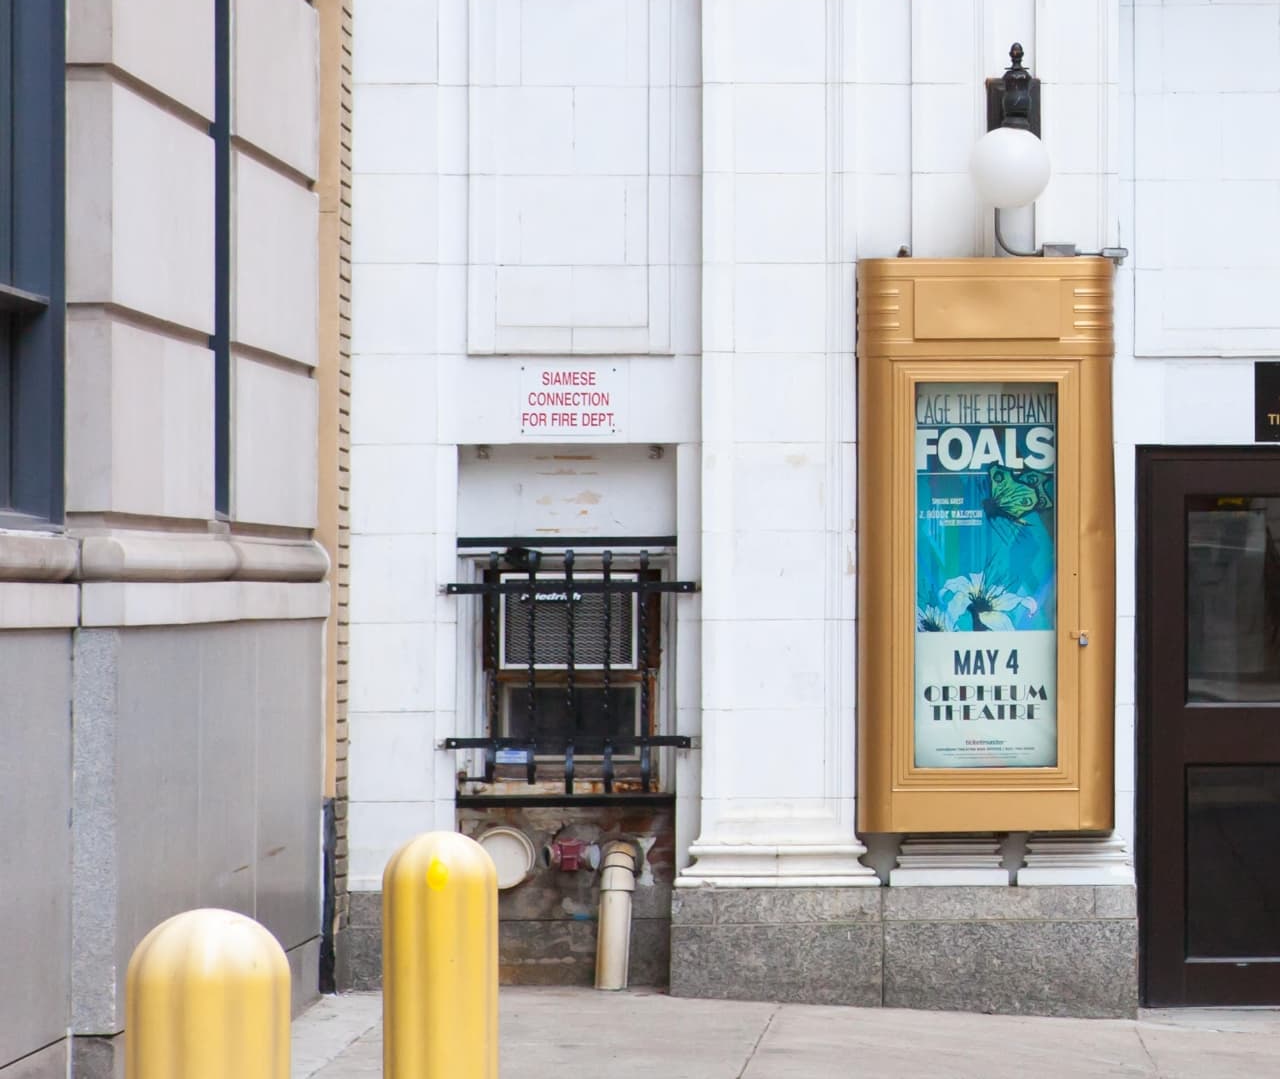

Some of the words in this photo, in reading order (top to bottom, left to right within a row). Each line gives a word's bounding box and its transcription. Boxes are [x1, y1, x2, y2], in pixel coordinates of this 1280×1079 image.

[542, 371, 596, 386] SIAMESE
[528, 392, 610, 407] CONNECTION
[915, 393, 951, 424] CAGE
[957, 393, 981, 424] THE
[987, 393, 1056, 424] ELEPHANT
[522, 412, 547, 427] FOR
[551, 412, 578, 427] FIRE
[582, 412, 616, 427] DEPT.
[916, 427, 1056, 471] FOALS
[953, 649, 999, 676] MAY
[1005, 648, 1019, 675] 4
[923, 684, 1048, 702] ORPHEUM
[930, 703, 1041, 721] THEATRE
